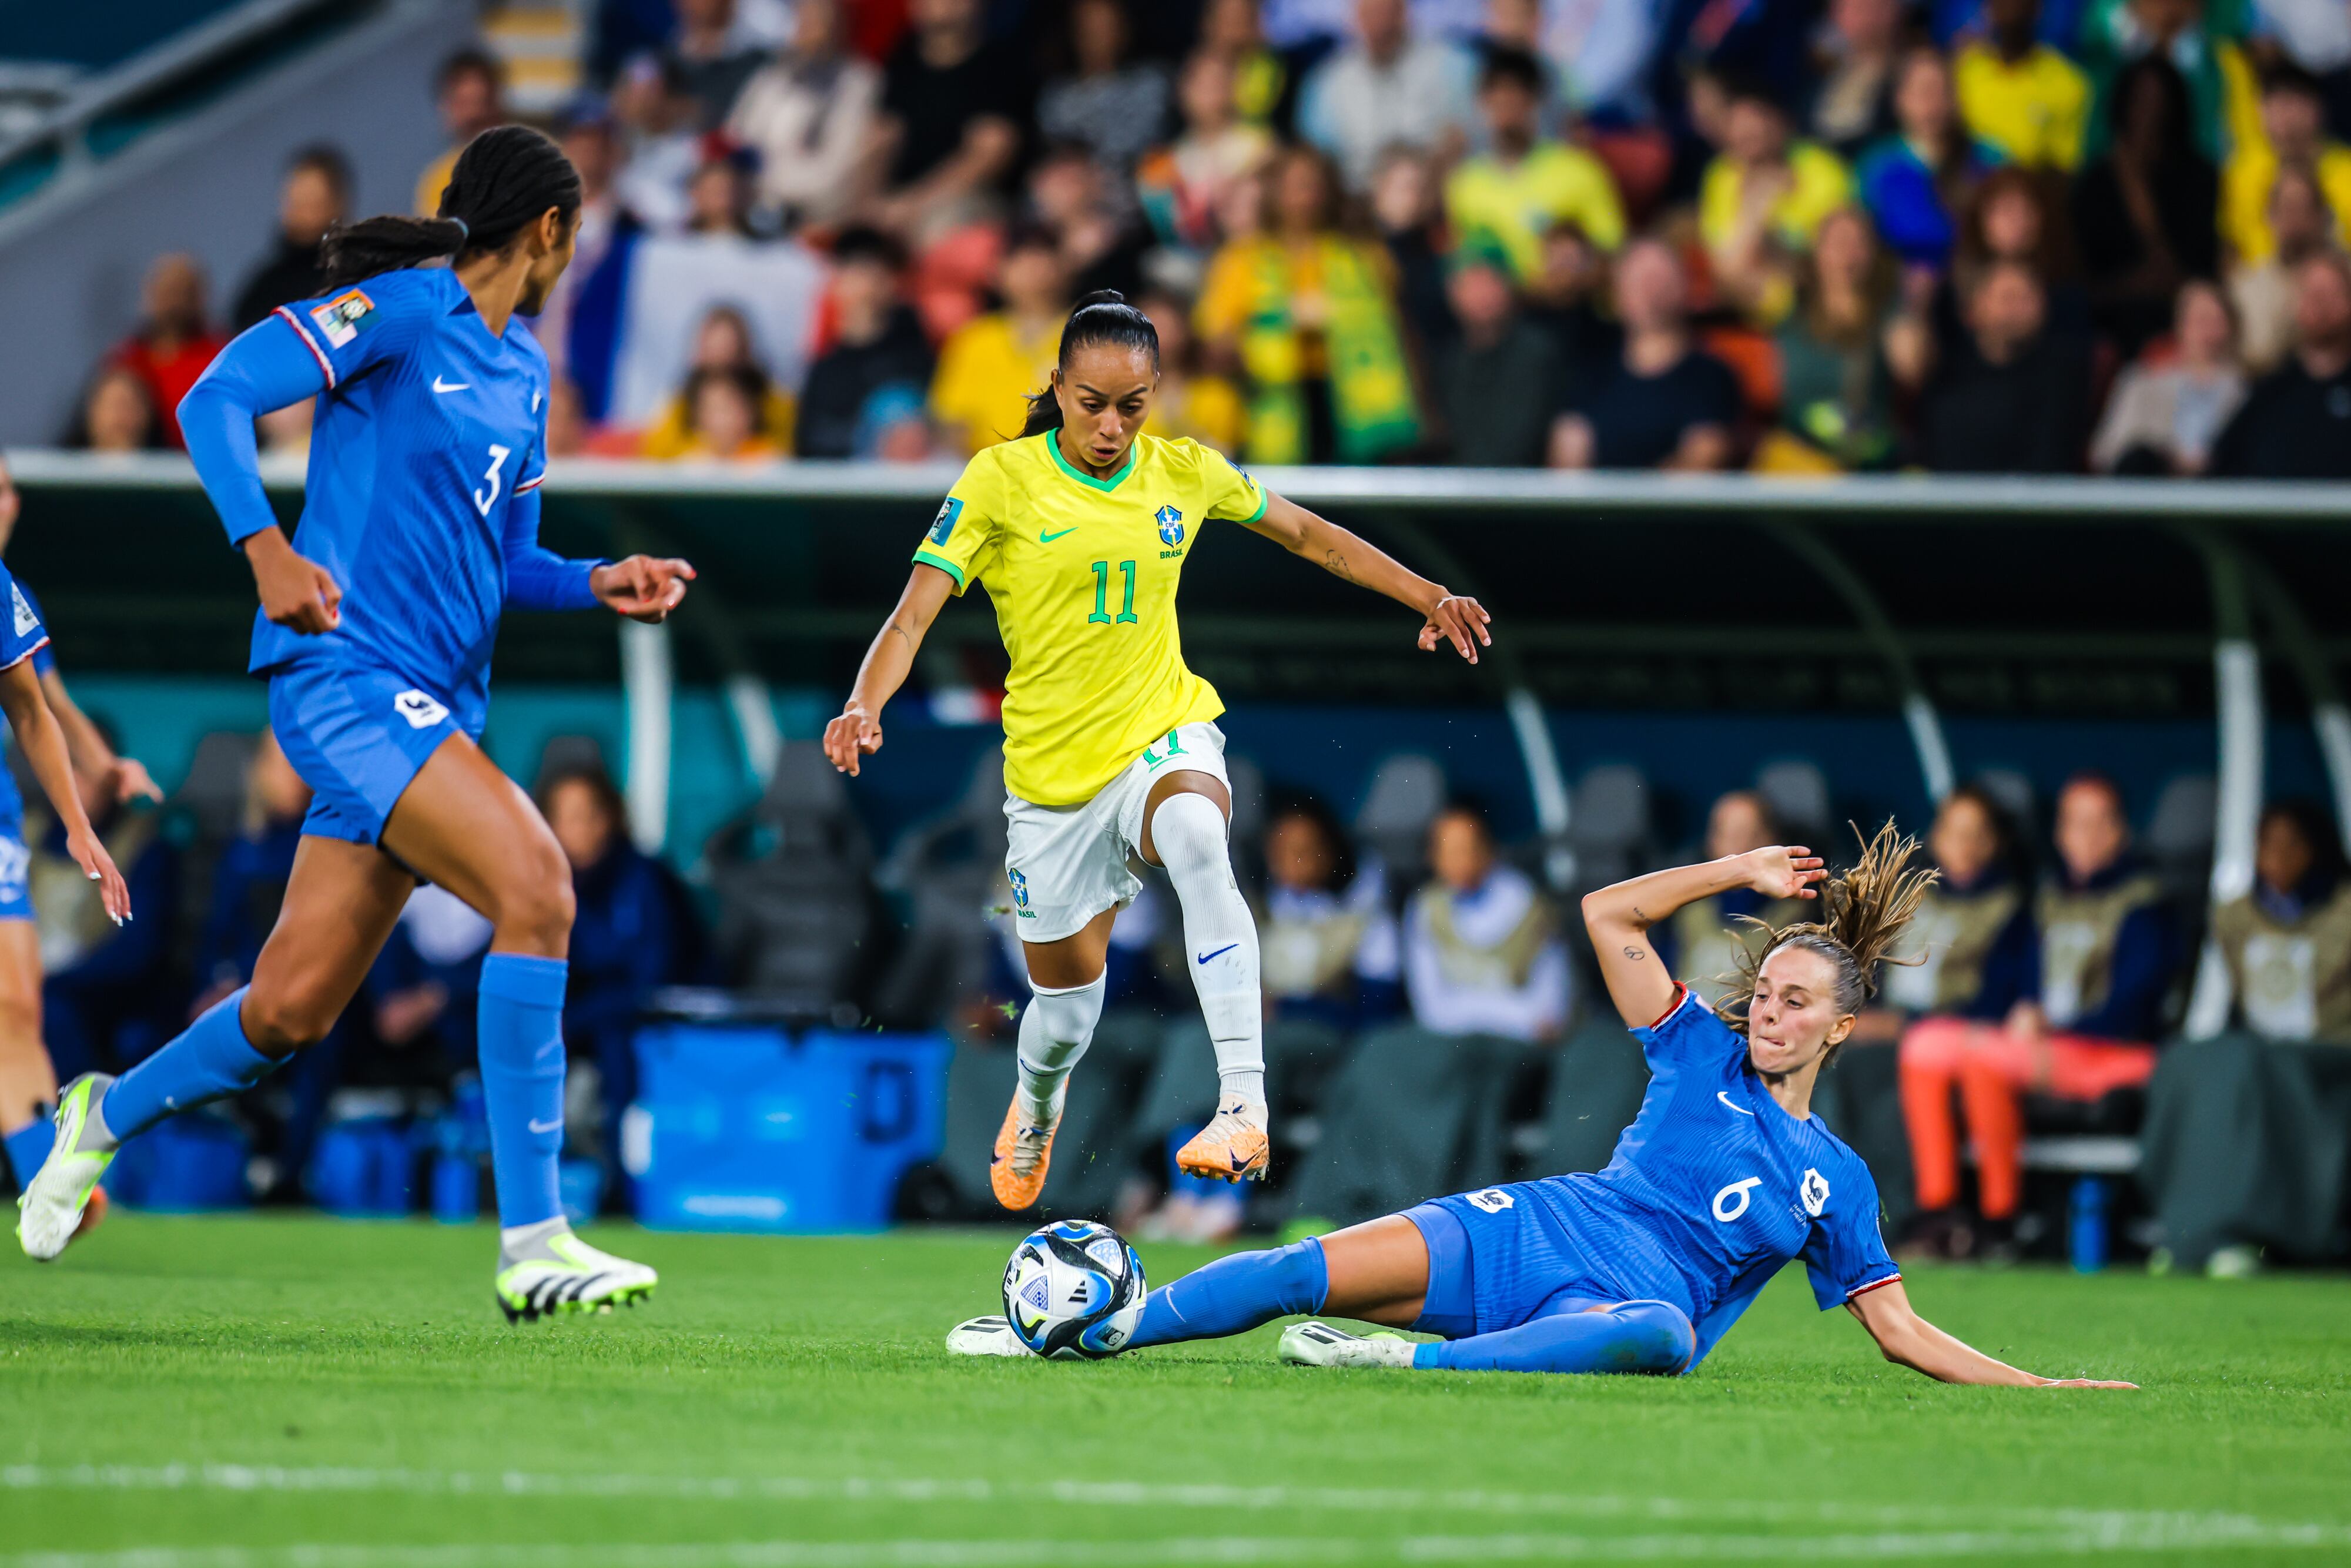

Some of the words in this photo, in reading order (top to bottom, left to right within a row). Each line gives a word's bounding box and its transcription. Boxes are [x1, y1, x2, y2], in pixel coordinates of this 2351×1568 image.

[474, 443, 511, 517] 3
[1160, 548, 1183, 559] BRASIL
[1088, 560, 1138, 624] 11
[1712, 1176, 1763, 1222] 6
